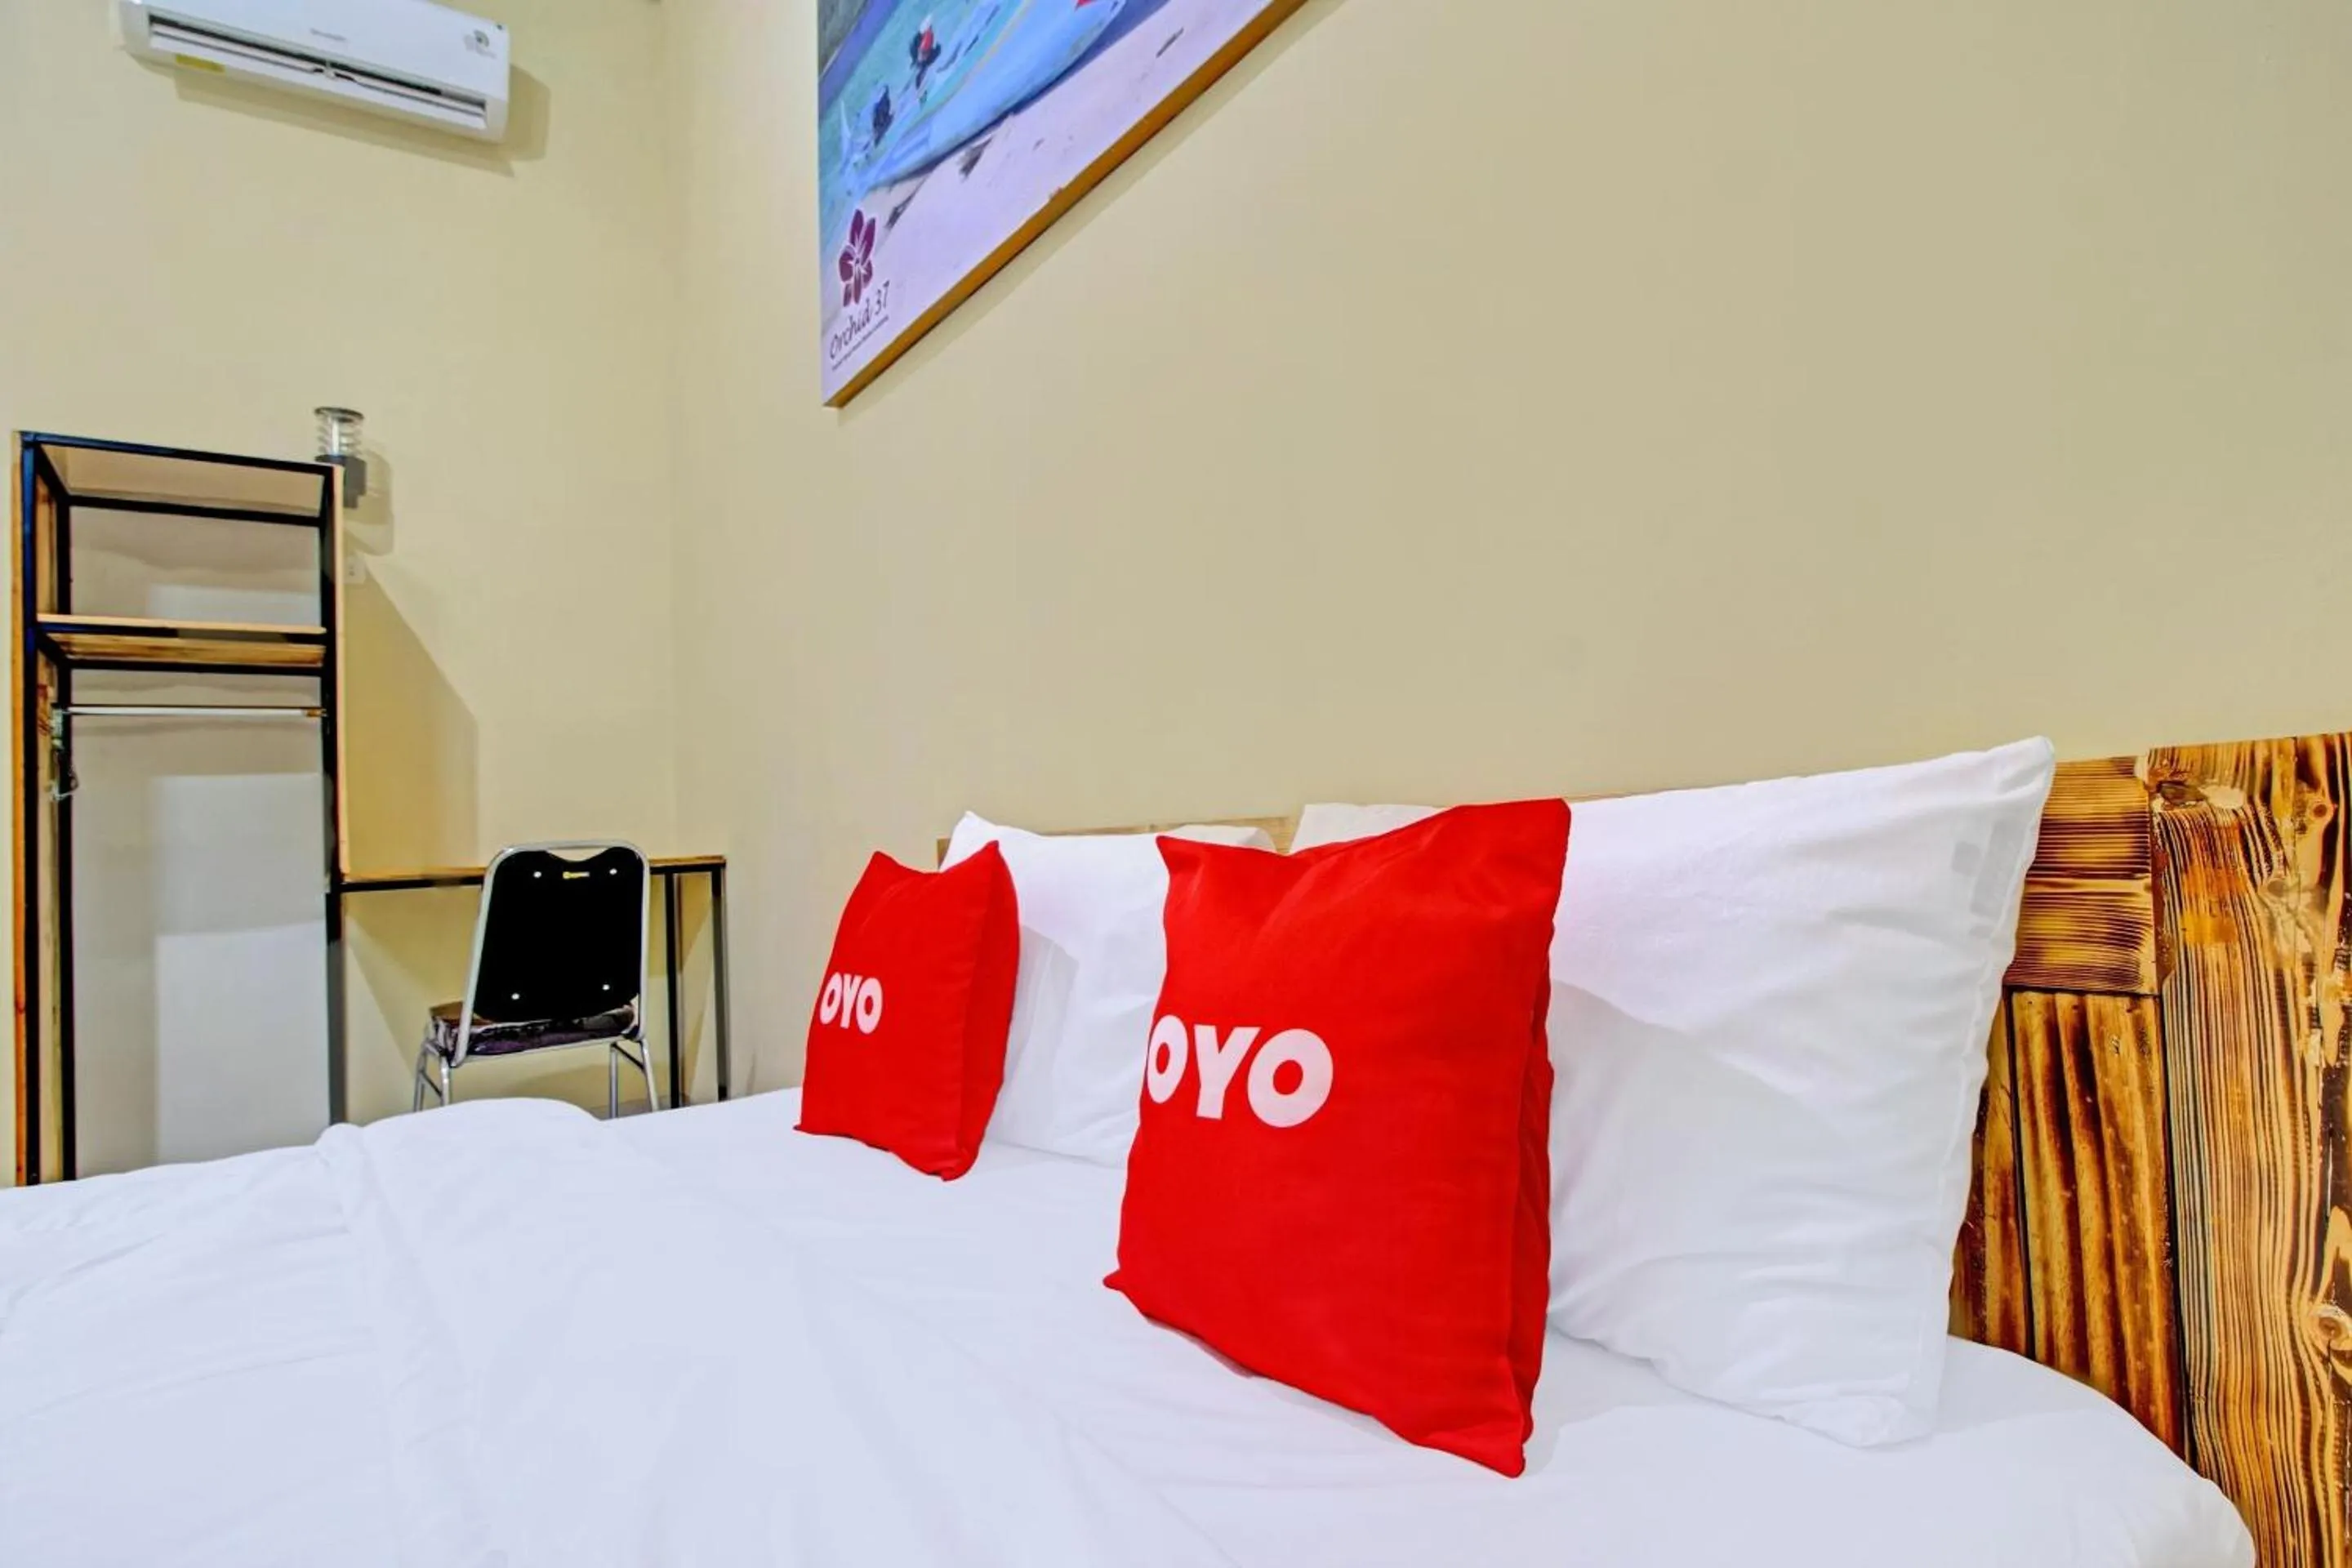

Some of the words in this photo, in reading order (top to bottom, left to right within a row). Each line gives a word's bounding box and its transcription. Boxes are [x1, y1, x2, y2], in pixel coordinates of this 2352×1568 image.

[830, 297, 870, 360] Orchid
[875, 279, 890, 315] 37
[819, 971, 884, 1035] OYO
[1147, 1014, 1334, 1128] OYO
